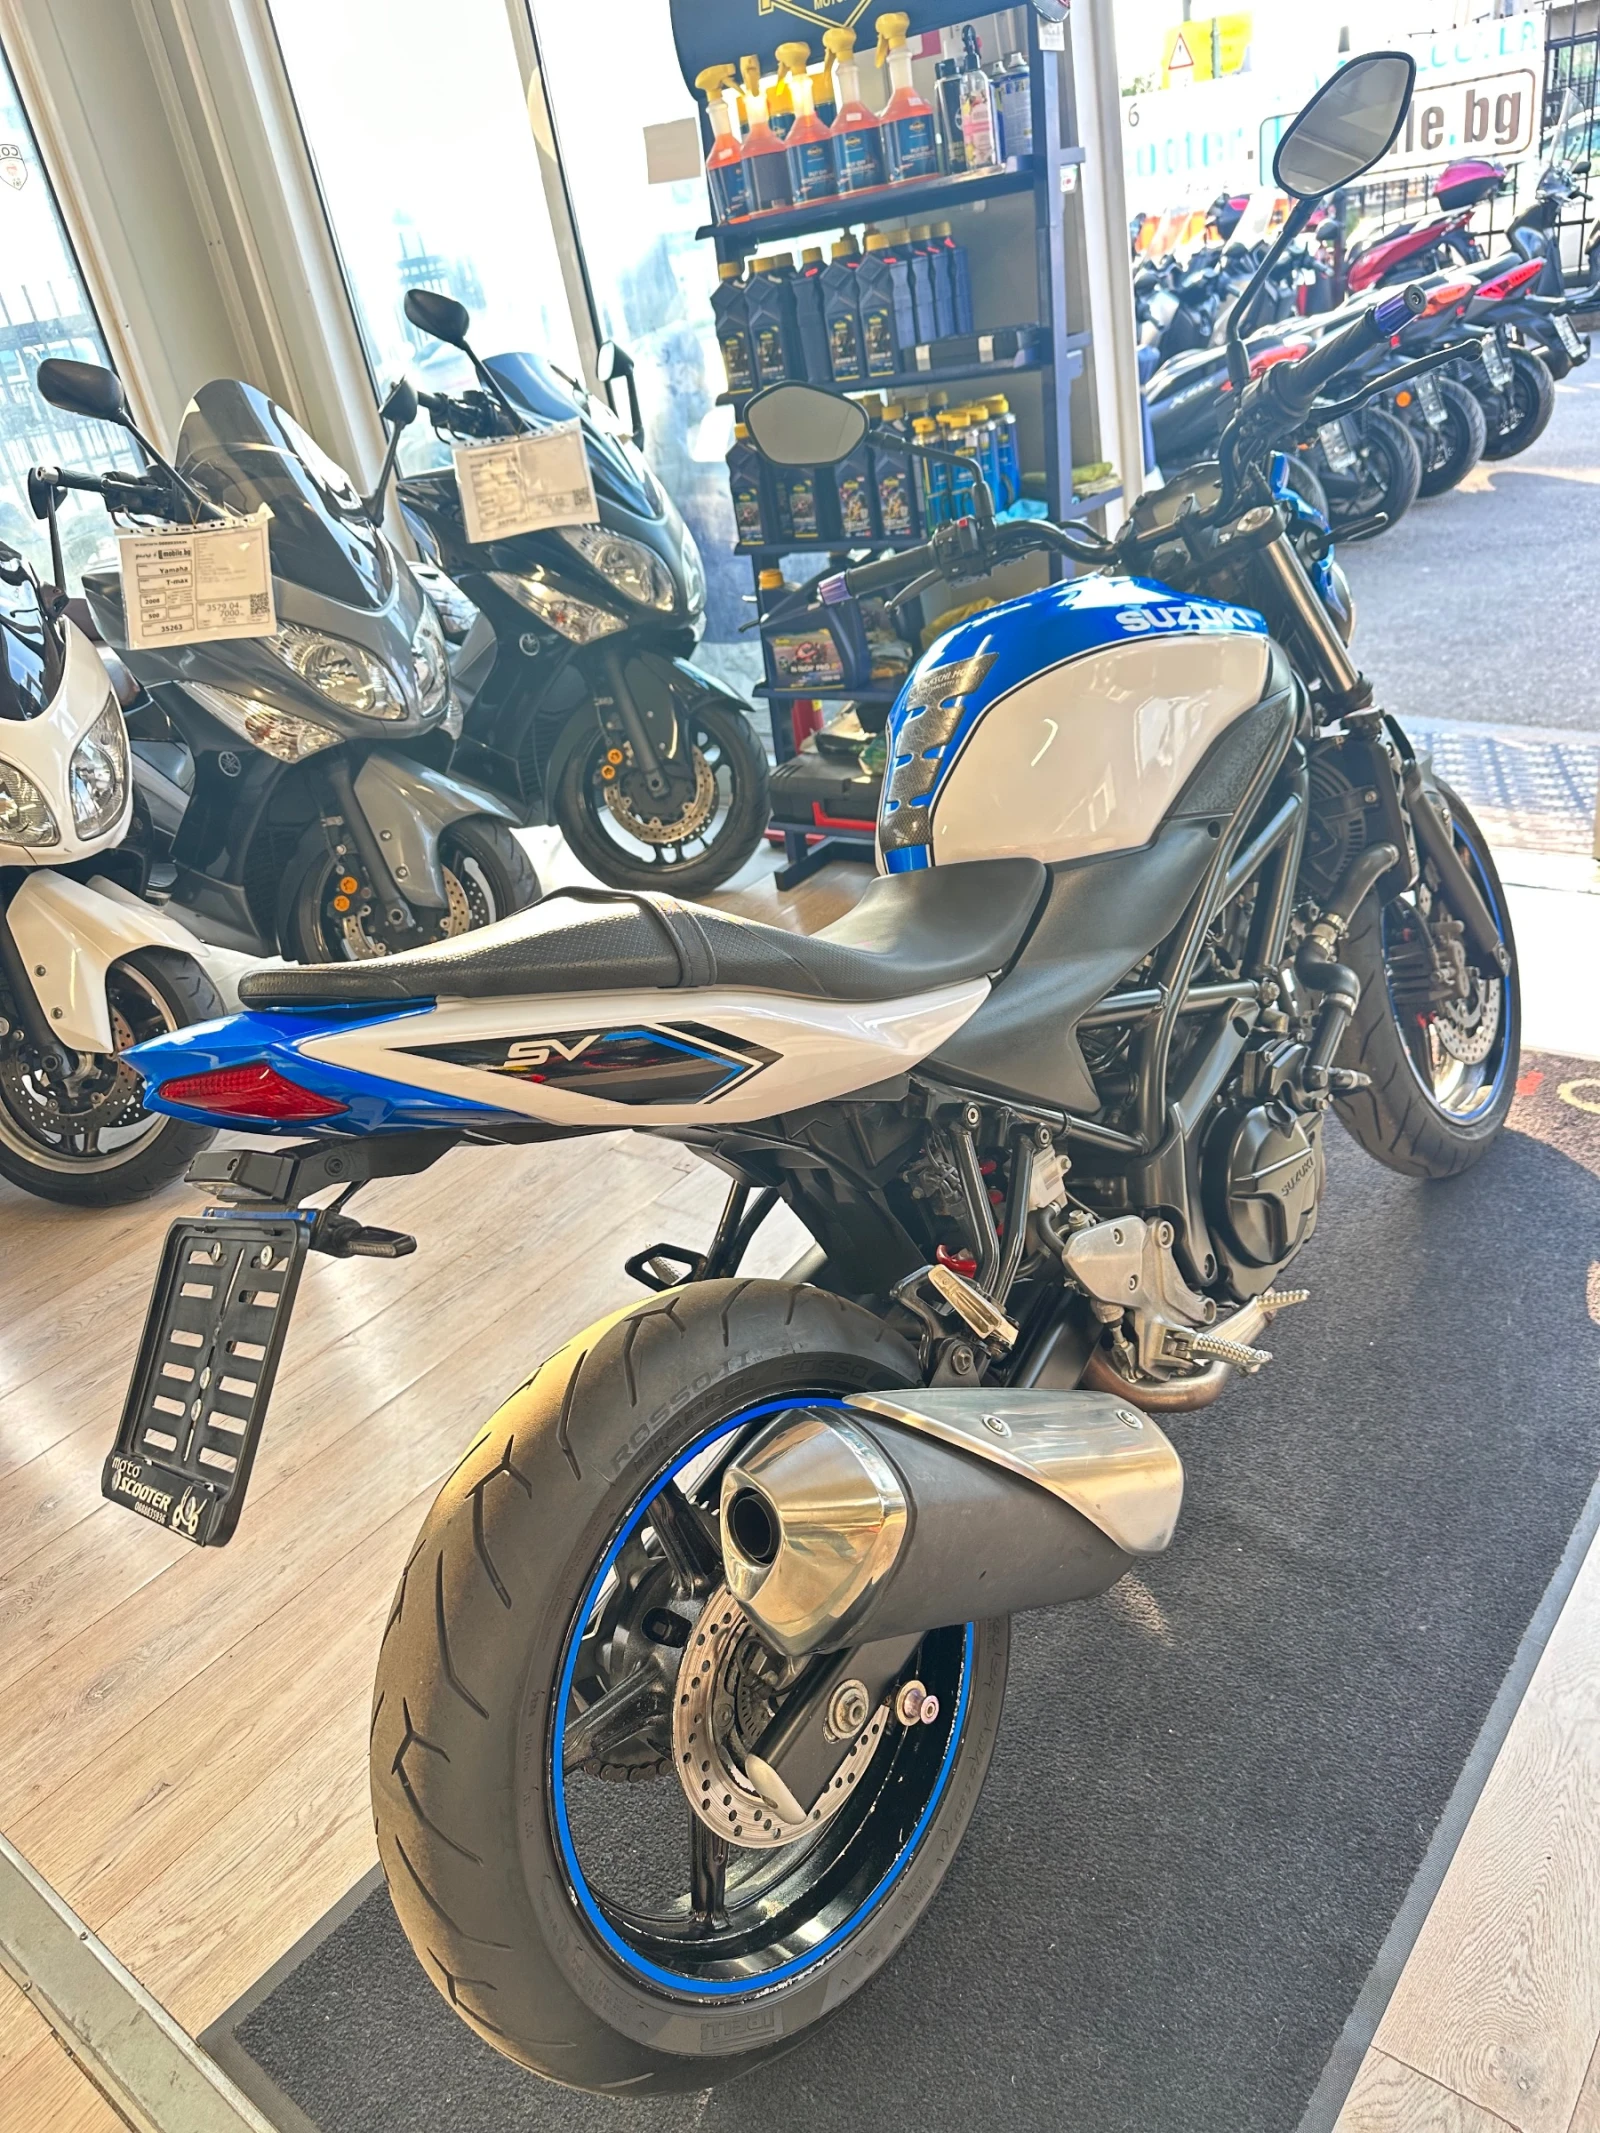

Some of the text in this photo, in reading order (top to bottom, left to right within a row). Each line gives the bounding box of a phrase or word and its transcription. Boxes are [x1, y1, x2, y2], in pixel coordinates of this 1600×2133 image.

[159, 566, 189, 574] Yamaha
[166, 578, 189, 586] T-max
[220, 608, 239, 617] 7000
[1115, 605, 1256, 632] SUZUKI
[161, 624, 183, 632] 35263
[502, 1033, 600, 1068] SV
[1281, 1156, 1315, 1197] SUZUKI
[609, 1370, 713, 1472] ROSSO
[112, 1456, 142, 1478] moto
[118, 1476, 173, 1512] SCOOTER
